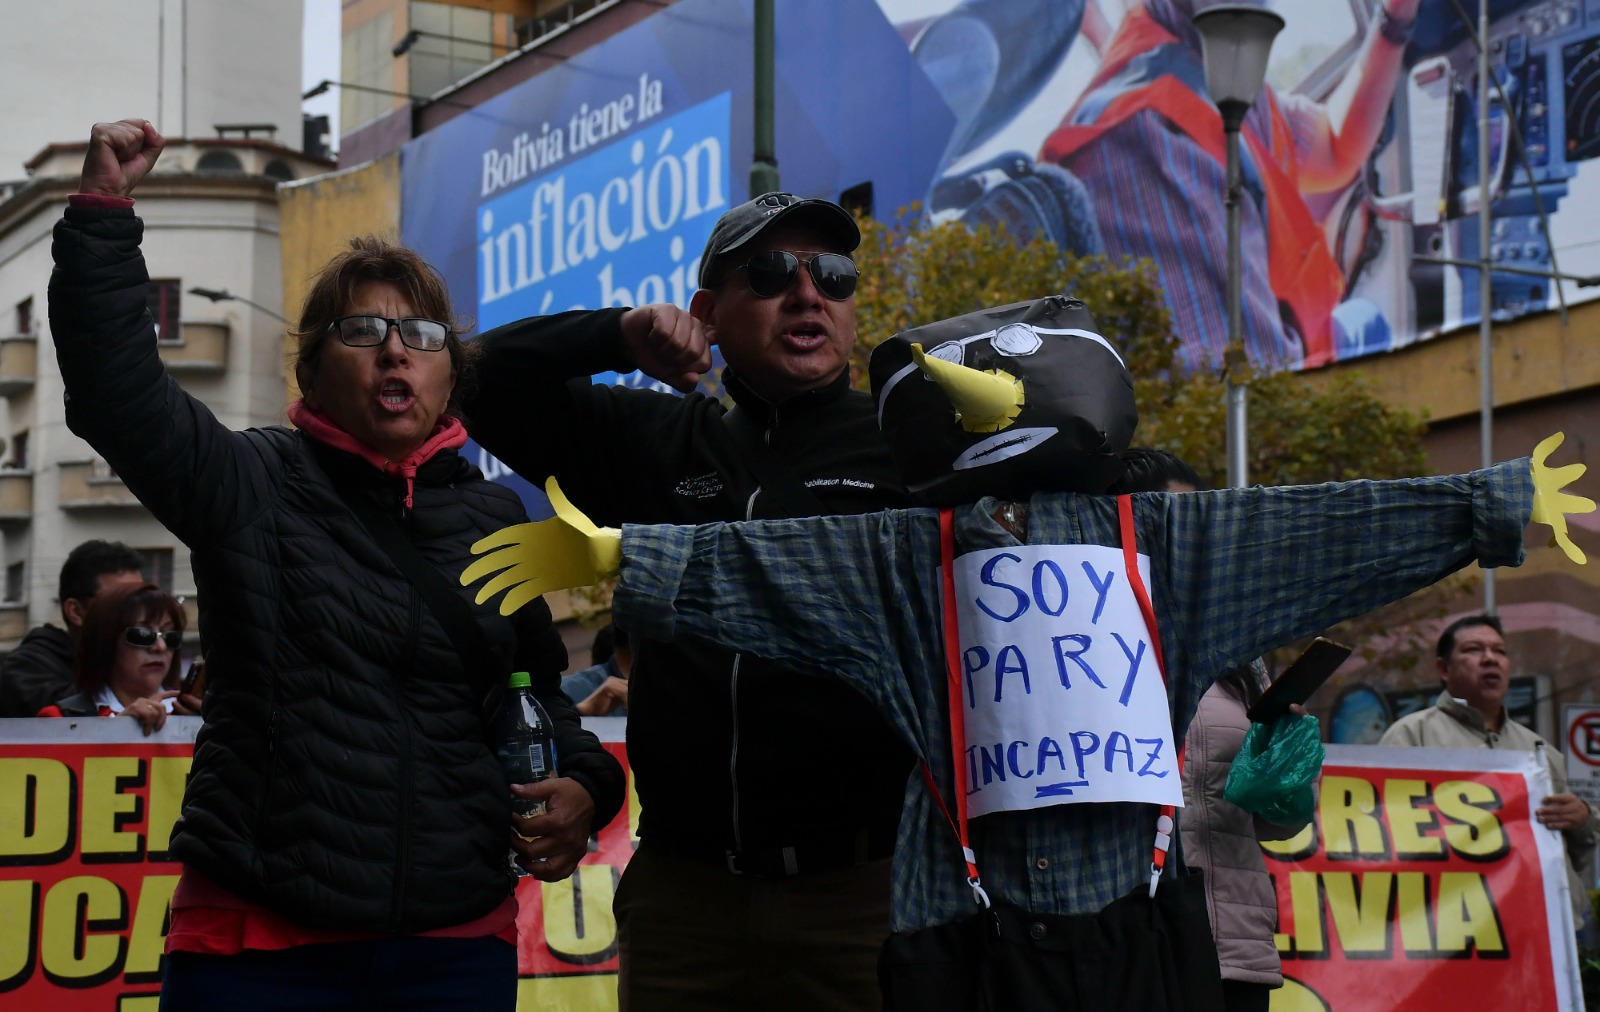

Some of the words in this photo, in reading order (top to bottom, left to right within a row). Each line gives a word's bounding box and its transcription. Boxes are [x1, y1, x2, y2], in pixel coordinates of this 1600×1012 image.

[481, 121, 564, 198] Bolivia
[569, 93, 634, 154] tiene
[638, 71, 664, 124] la
[479, 127, 726, 305] inflación
[842, 478, 875, 490] Medicine
[975, 552, 1115, 626] SOY
[962, 631, 1147, 710] PARY
[965, 730, 1170, 795] INCAPAZ
